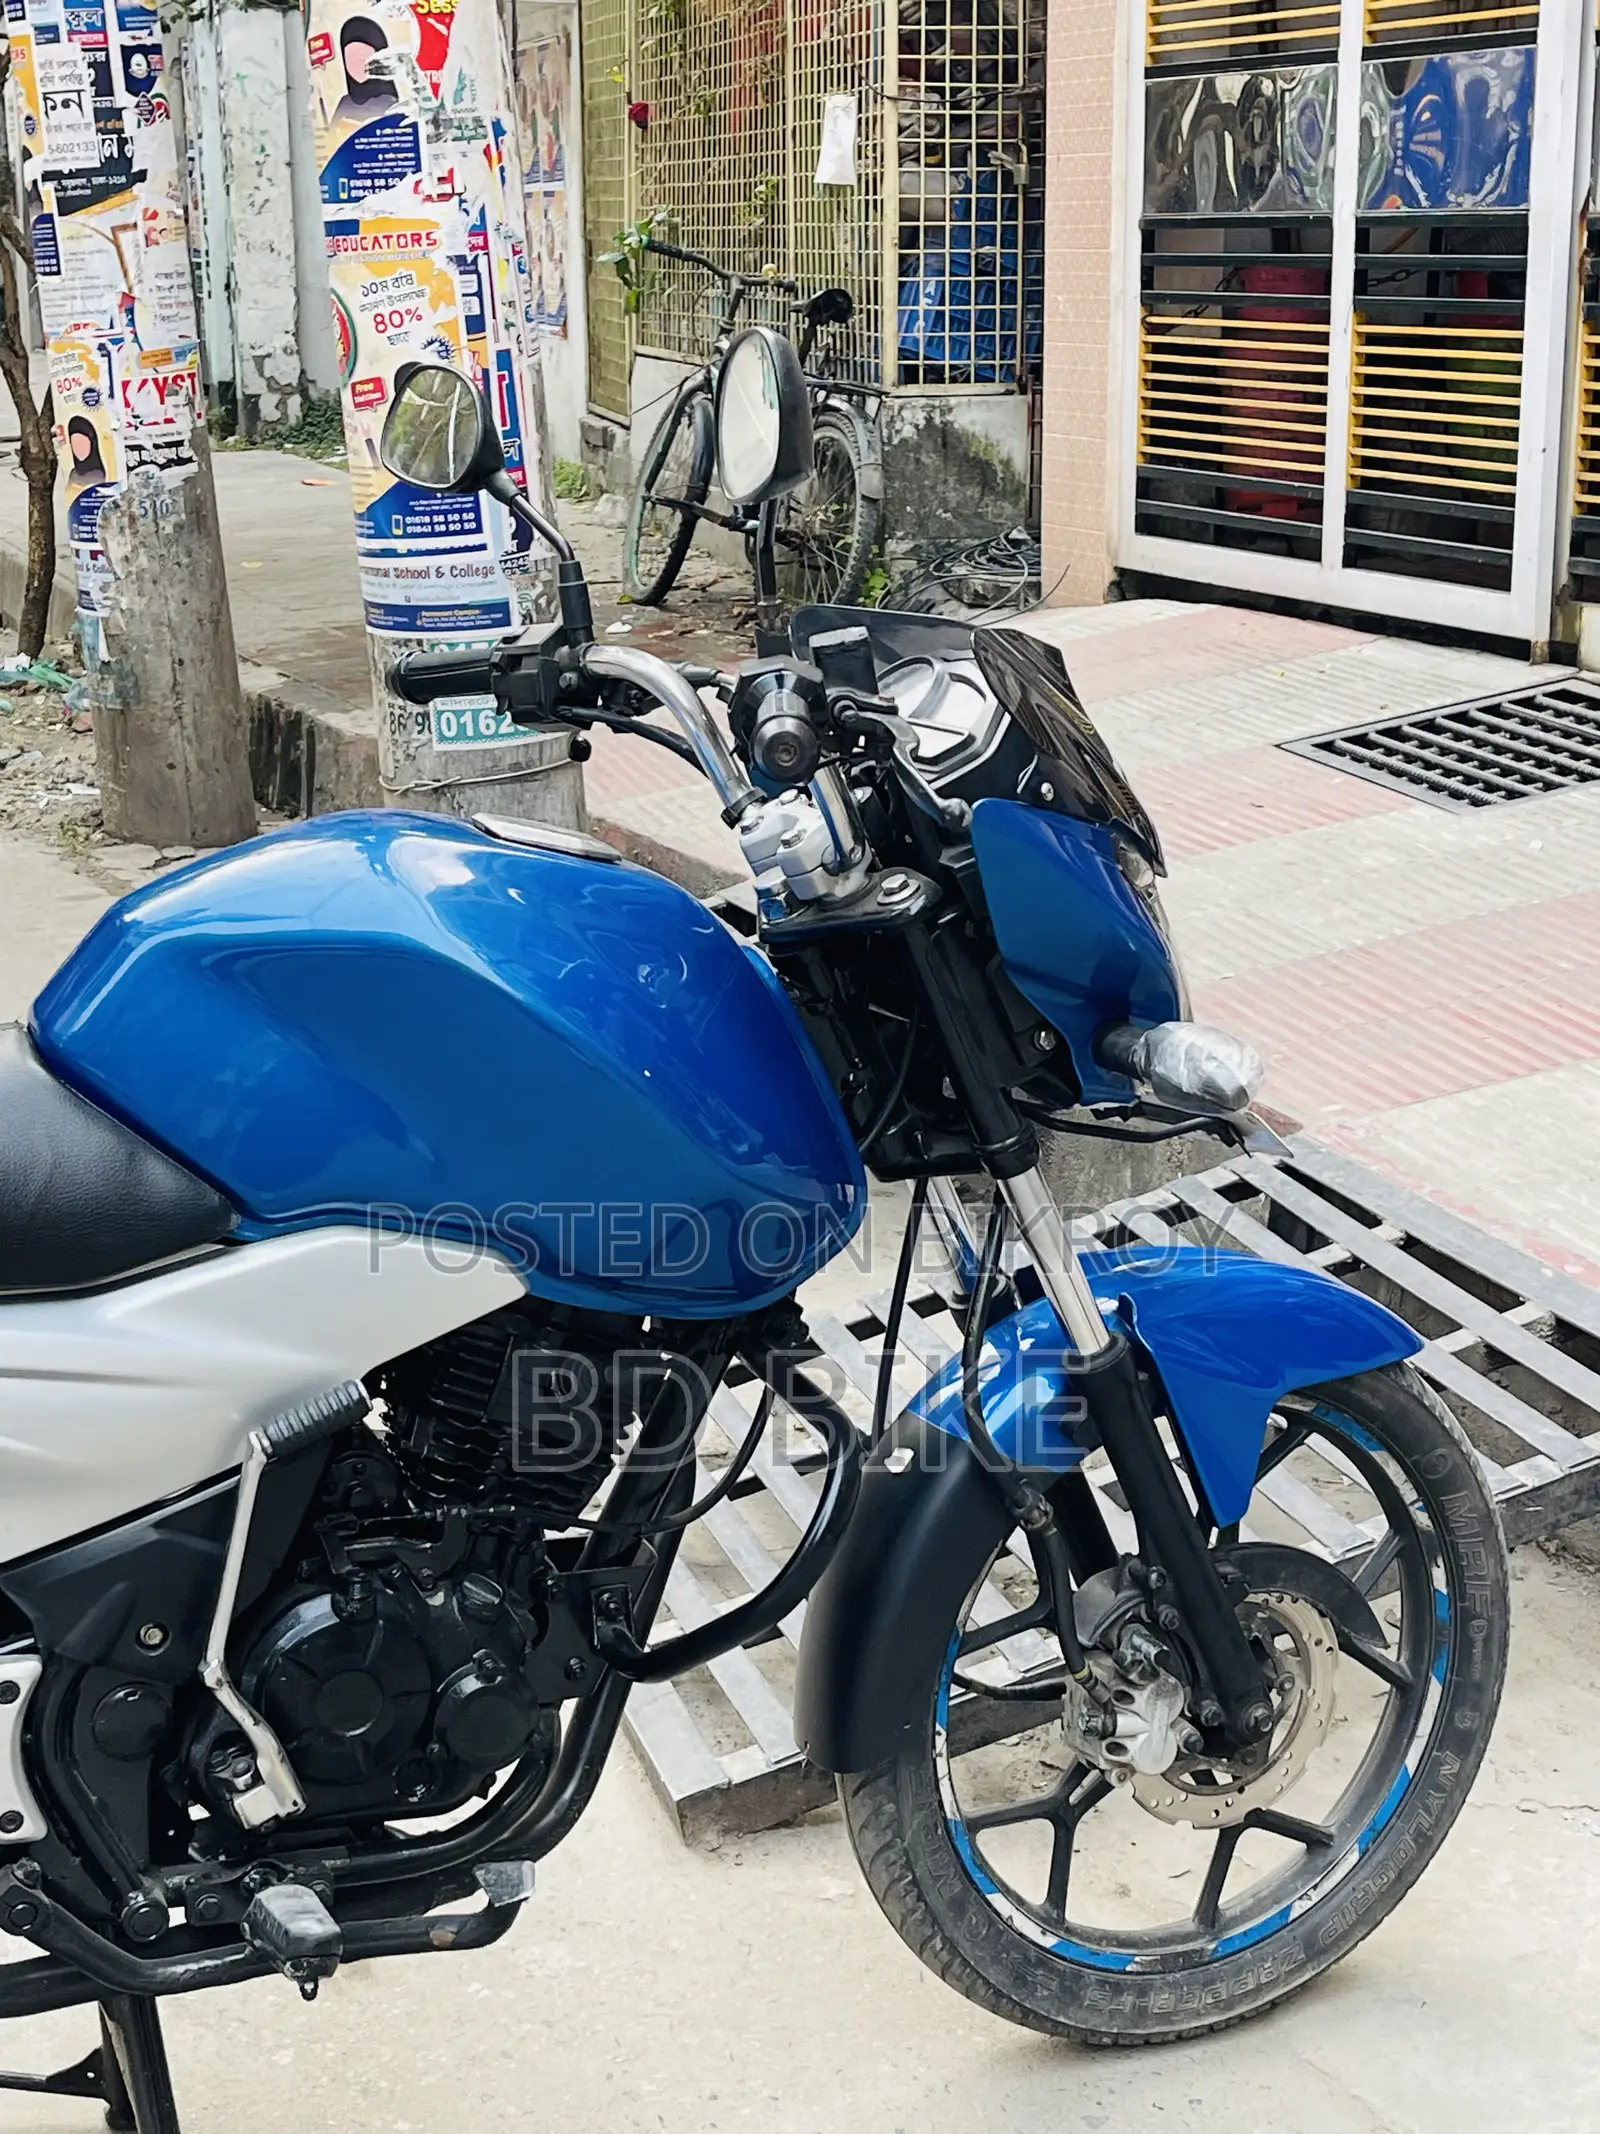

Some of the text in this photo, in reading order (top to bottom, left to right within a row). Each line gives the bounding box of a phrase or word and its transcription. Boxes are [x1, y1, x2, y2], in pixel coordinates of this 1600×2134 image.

[373, 307, 423, 334] 80%
[56, 377, 83, 394] 80%
[355, 382, 374, 393] Free
[393, 567, 430, 580] School
[450, 564, 496, 579] College
[440, 711, 528, 738] 0162
[1438, 1491, 1493, 1619] MRF
[1319, 1750, 1462, 1947] NYLOGRIP
